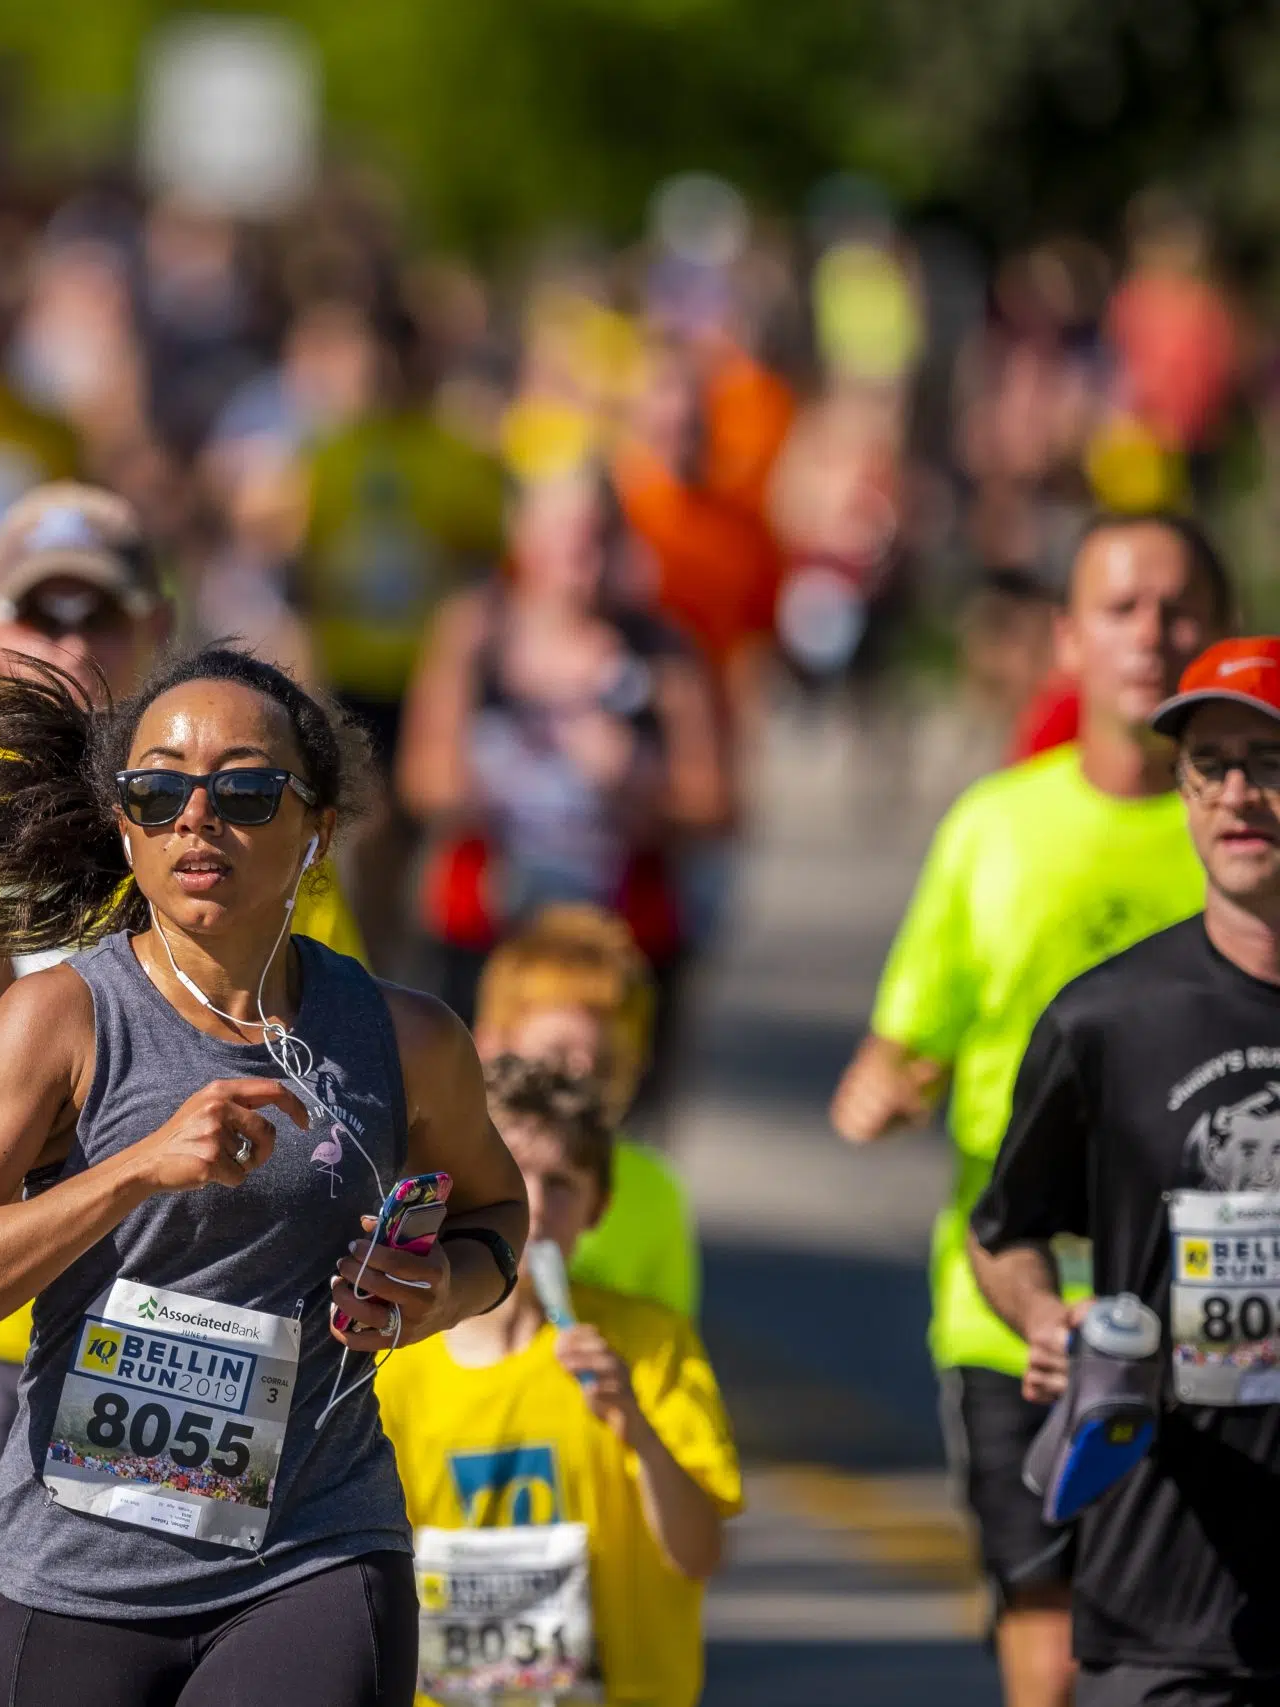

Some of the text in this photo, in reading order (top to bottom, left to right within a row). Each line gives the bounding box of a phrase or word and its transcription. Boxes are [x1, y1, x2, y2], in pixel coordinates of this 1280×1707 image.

[181, 1329, 201, 1340] JUNE
[1203, 1296, 1280, 1341] 80
[123, 1334, 244, 1382] BELLIN
[261, 1375, 289, 1387] CORRAL
[267, 1388, 278, 1404] 3
[86, 1392, 255, 1478] 8055
[444, 1621, 568, 1668] 8031
